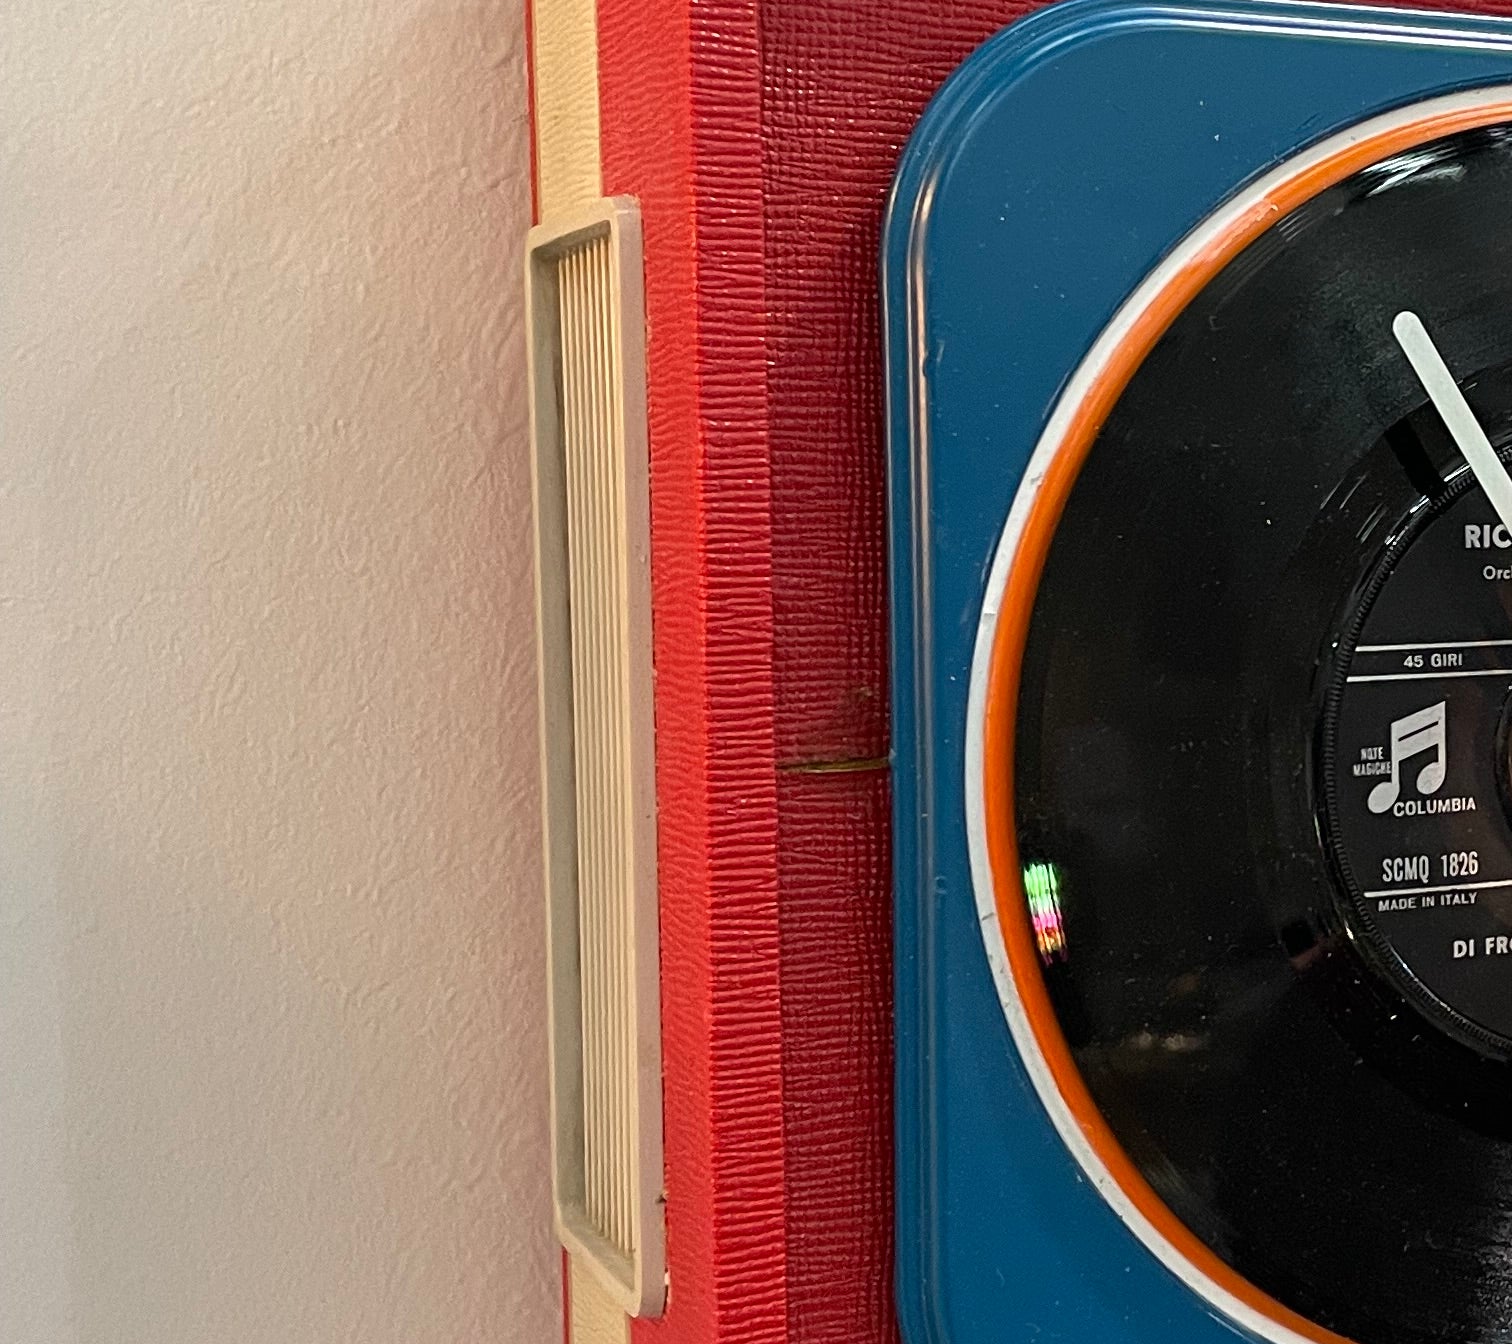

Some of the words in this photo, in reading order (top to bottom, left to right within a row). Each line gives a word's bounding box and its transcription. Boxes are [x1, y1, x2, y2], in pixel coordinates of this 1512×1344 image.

[1403, 655, 1424, 668] 45
[1430, 653, 1463, 668] GIRI
[1360, 747, 1383, 760] NOTE
[1393, 797, 1476, 817] COLUMBIA
[1382, 855, 1429, 884] SCMQ
[1440, 851, 1478, 877] 1826
[1378, 897, 1417, 912] MADE
[1421, 896, 1435, 908] IN
[1440, 892, 1478, 906] ITALY
[1453, 939, 1475, 958] DI
